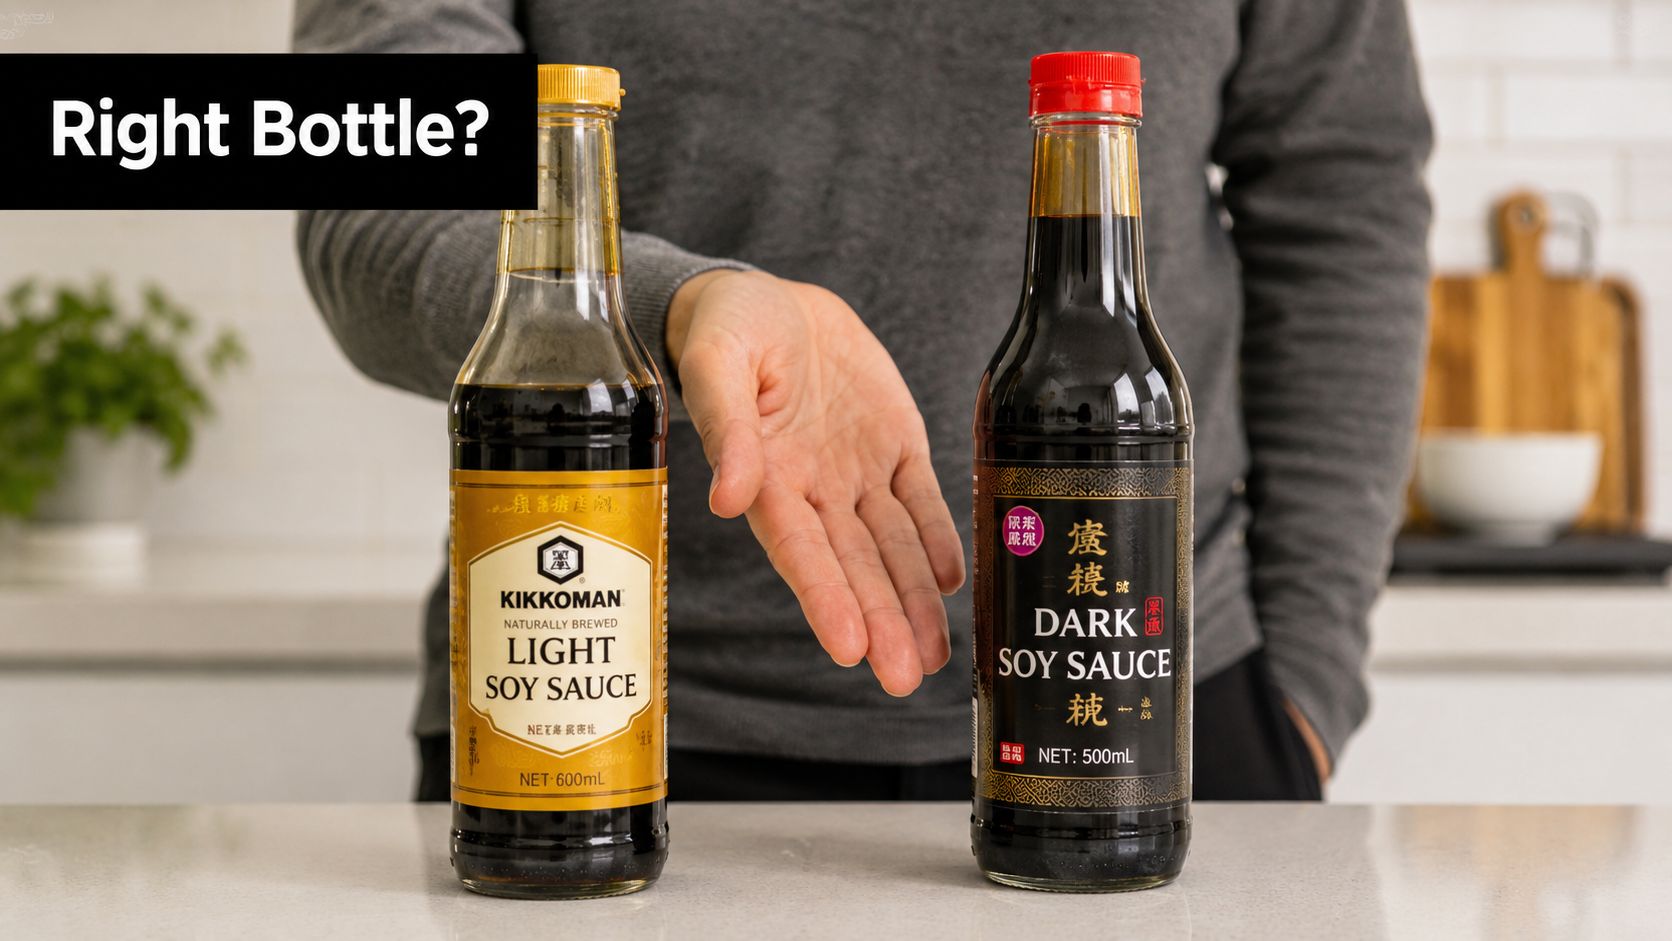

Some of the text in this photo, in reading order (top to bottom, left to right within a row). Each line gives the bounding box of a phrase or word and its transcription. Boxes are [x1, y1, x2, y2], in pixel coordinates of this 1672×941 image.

[501, 590, 621, 609] KIKKOMAN
[504, 618, 618, 630] NATURALLY BREWED
[1034, 608, 1137, 637] DARK
[507, 636, 616, 665] LIGHT
[998, 648, 1171, 680] SOY SAUCE
[485, 673, 637, 701] SOY SAUCE
[1038, 748, 1077, 764] NET:
[1082, 748, 1134, 765] 500mL
[556, 772, 605, 787] 600mL
